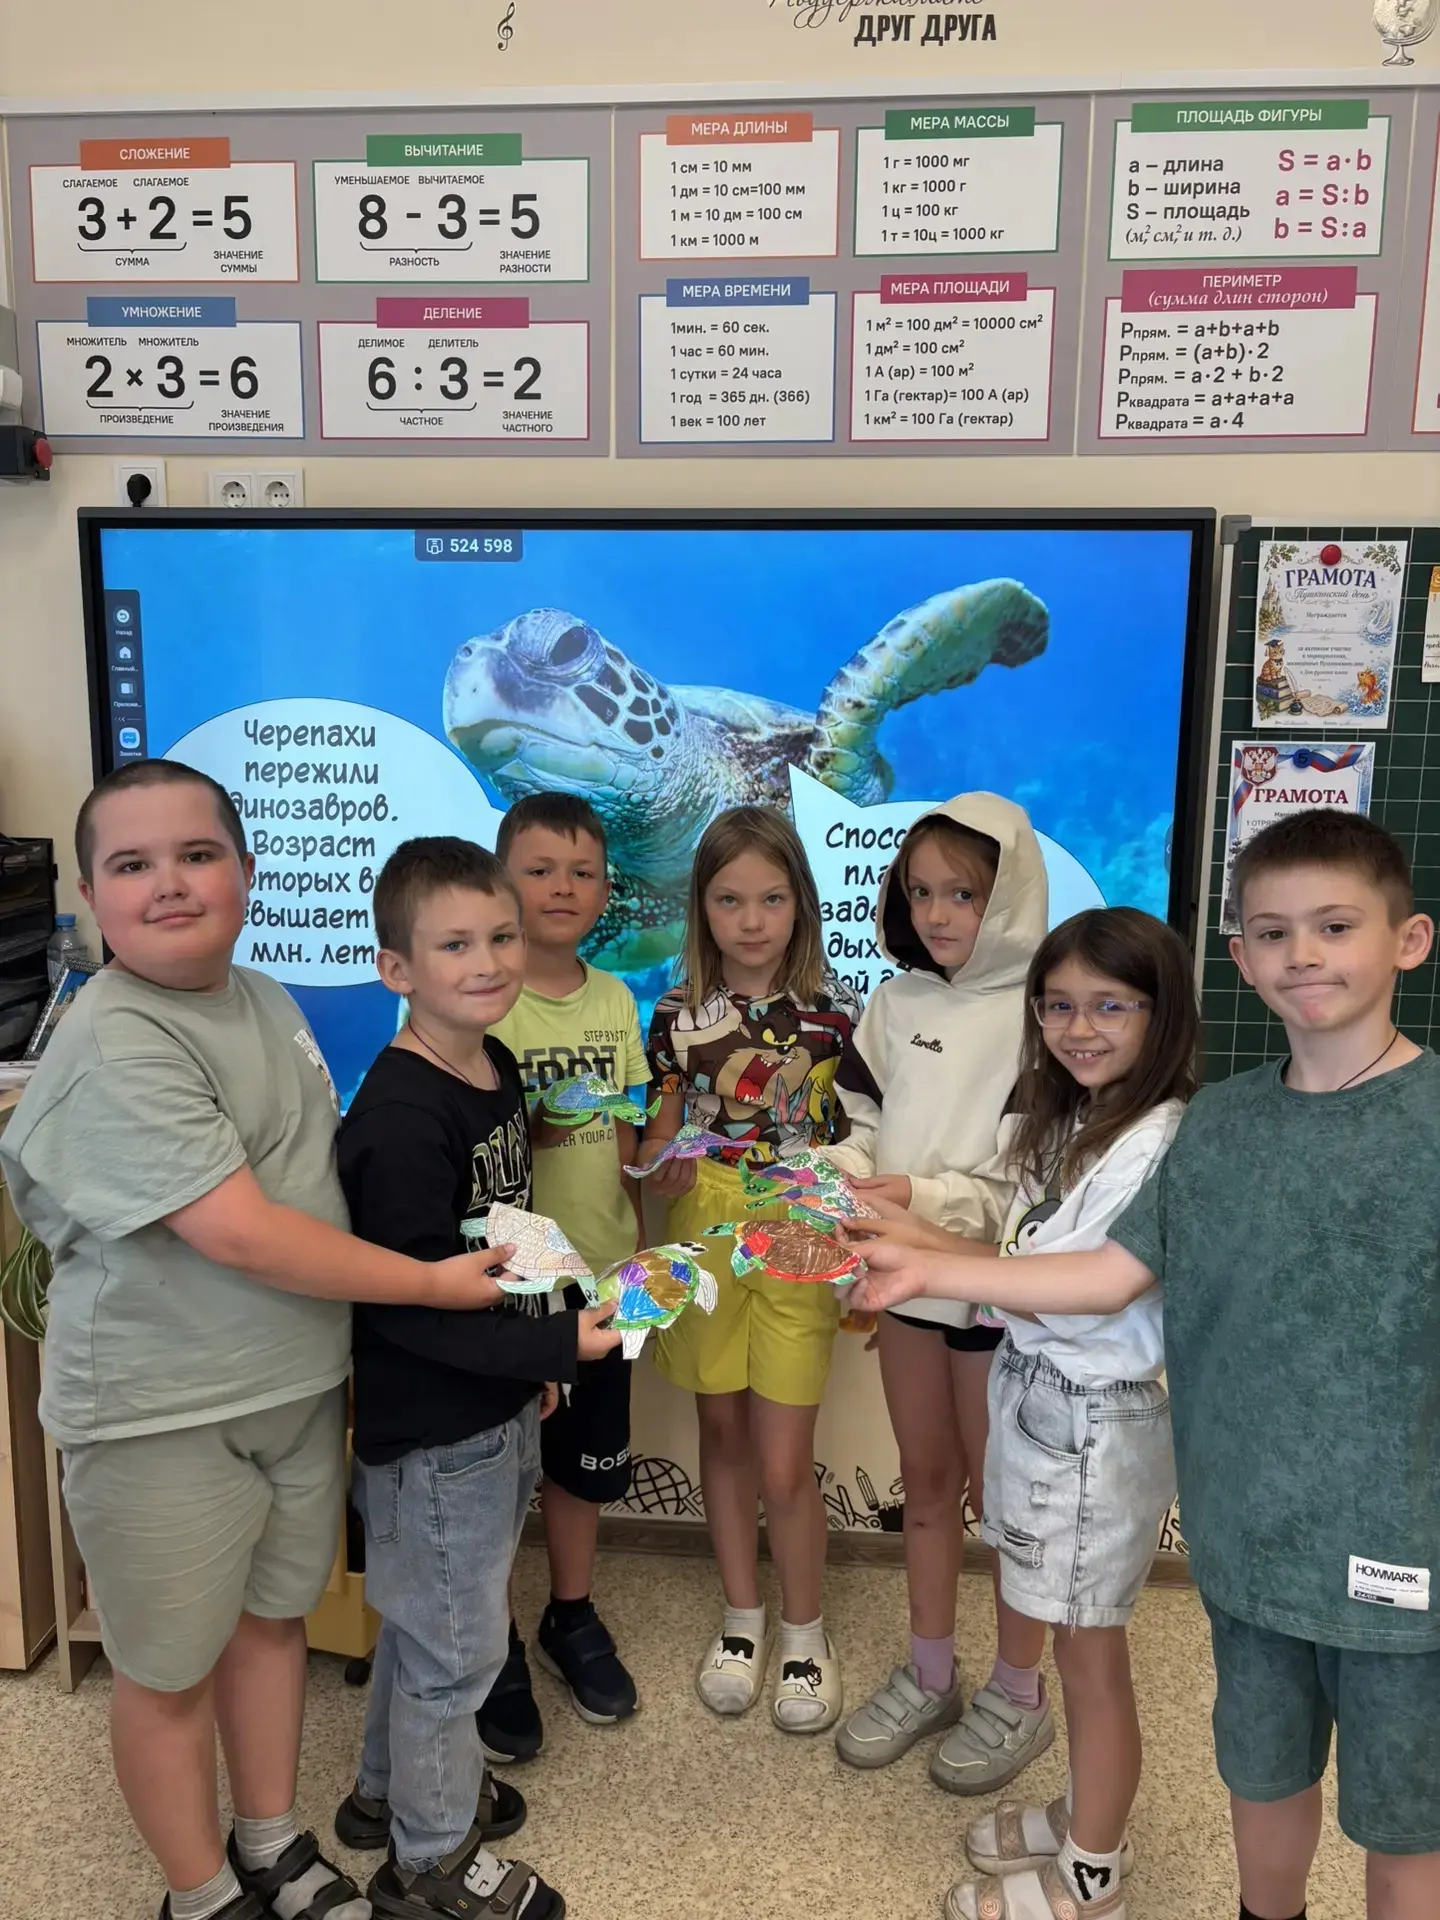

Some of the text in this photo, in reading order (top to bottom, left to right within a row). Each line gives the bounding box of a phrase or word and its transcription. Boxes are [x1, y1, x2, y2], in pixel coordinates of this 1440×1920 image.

[854, 14, 996, 46] ДРУГ ДРУГА
[911, 115, 1009, 130] МЕРА МАССЫ
[1177, 109, 1322, 124] ПЛОЩАДЬ ФИГУРЫ
[691, 121, 787, 136] МЕРА ДЛИНЫ
[120, 148, 190, 160] СЛОЖЕНИЕ
[405, 144, 483, 157] ВЫЧИТАНИЕ
[680, 163, 697, 173] см
[714, 161, 728, 172] 10
[732, 162, 751, 172] мм
[894, 159, 899, 168] г
[916, 155, 948, 167] 1000
[953, 157, 970, 167] мг
[1163, 158, 1224, 174] длина
[1278, 150, 1295, 171] S
[62, 177, 189, 188] СЛАГАЕМОЕ СЛАГАЕМОЕ
[334, 175, 485, 185] УМЕНЬШАЕМОЕ ВЫЧИТАЕМОЕ
[1128, 180, 1140, 196] b
[1164, 181, 1241, 199] ширина
[680, 212, 690, 221] м
[706, 209, 720, 221] 10
[724, 211, 742, 222] дм
[757, 208, 781, 220] 100
[785, 209, 802, 219] см
[1127, 203, 1139, 219] S
[1164, 205, 1250, 220] площадь
[953, 227, 986, 240] 1000
[990, 229, 1004, 239] кг
[213, 251, 263, 260] ЗНАЧЕНИЕ
[500, 250, 551, 259] ЗНАЧЕНИЕ
[115, 257, 150, 267] СУММА
[220, 264, 257, 273] СУММЫ
[389, 257, 439, 267] РАЗНОСТЬ
[500, 264, 551, 273] РАЗНОСТИ
[1203, 274, 1282, 288] ПЕРИМЕТР
[682, 284, 791, 297] МЕРА ВРЕМЕНИ
[891, 281, 1010, 295] МЕРА ПЛОЩАДИ
[1149, 288, 1328, 309] (сумма длин сторон)
[121, 307, 202, 318] УМНОЖЕНИЕ
[424, 308, 482, 320] ДЕЛЕНИЕ
[722, 321, 739, 333] 60
[743, 323, 769, 333] сек.
[907, 319, 930, 330] 100
[974, 317, 1015, 329] 10000
[66, 338, 199, 346] МНОЖИТЕЛЬ МНОЖИТЕЛЬ
[358, 339, 479, 348] ДЕЛИМОЕ ДЕЛИТЕЛЬ
[680, 369, 716, 382] сутки
[732, 367, 748, 378] 24
[752, 368, 782, 378] часа
[875, 390, 889, 401] Га
[961, 389, 984, 400] 100
[1002, 388, 1029, 403] (ар)
[100, 415, 174, 424] ПРОИЗВЕДЕНИЕ
[221, 410, 270, 418] ЗНАЧЕНИЕ
[502, 411, 553, 419] ЗНАЧЕНИЕ
[209, 423, 284, 432] ПРОИЗВЕДЕНИЯ
[400, 417, 443, 426] ЧАСТНОЕ
[502, 424, 553, 433] ЧАСТНОГО
[450, 539, 513, 554] 524 598
[1285, 568, 1376, 588] ГРАМОТА
[1351, 590, 1370, 599] день
[244, 719, 376, 752] Черепахи
[245, 759, 379, 788] пережили
[1254, 789, 1349, 803] ГРАМОТА
[253, 830, 375, 862] Возраст
[251, 942, 311, 963] млн.
[584, 1031, 604, 1042] STEP
[580, 1130, 604, 1144] YOUR
[1356, 1563, 1418, 1583] HOWMARK
